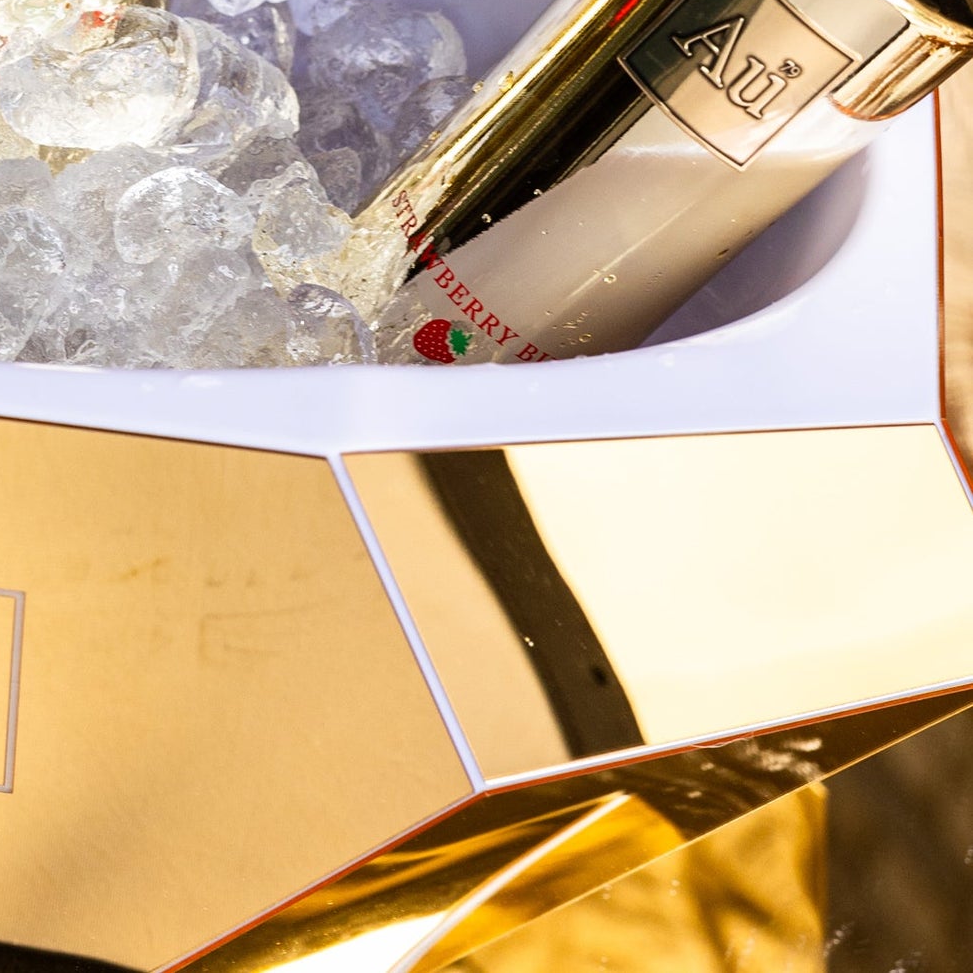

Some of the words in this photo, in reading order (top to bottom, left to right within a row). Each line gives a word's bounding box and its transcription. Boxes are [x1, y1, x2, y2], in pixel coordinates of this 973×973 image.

[670, 15, 788, 121] Au
[778, 58, 803, 79] 79
[391, 189, 521, 347] STRAWBERRY
